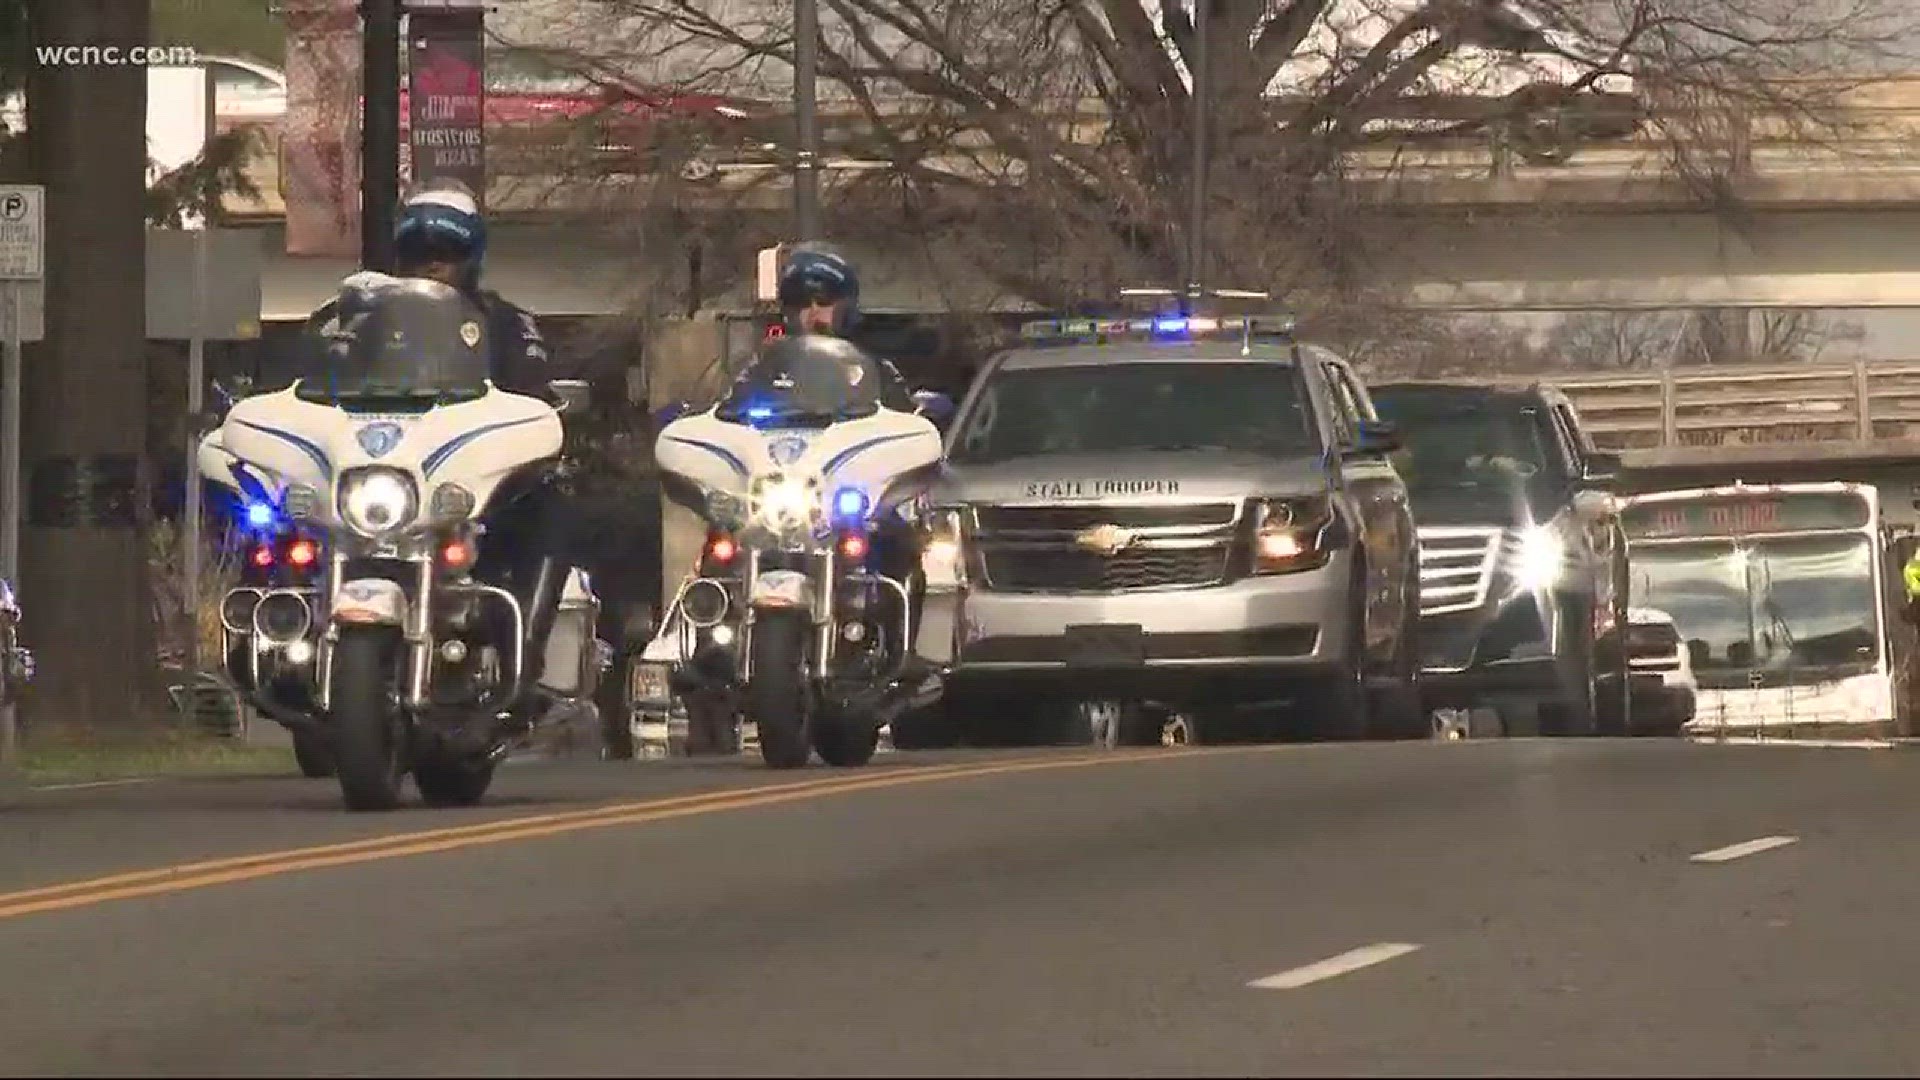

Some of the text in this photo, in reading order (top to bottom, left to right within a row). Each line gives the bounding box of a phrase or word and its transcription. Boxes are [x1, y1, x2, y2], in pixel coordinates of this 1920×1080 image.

[6, 198, 21, 216] P
[1026, 479, 1180, 498] STATE TROOPER
